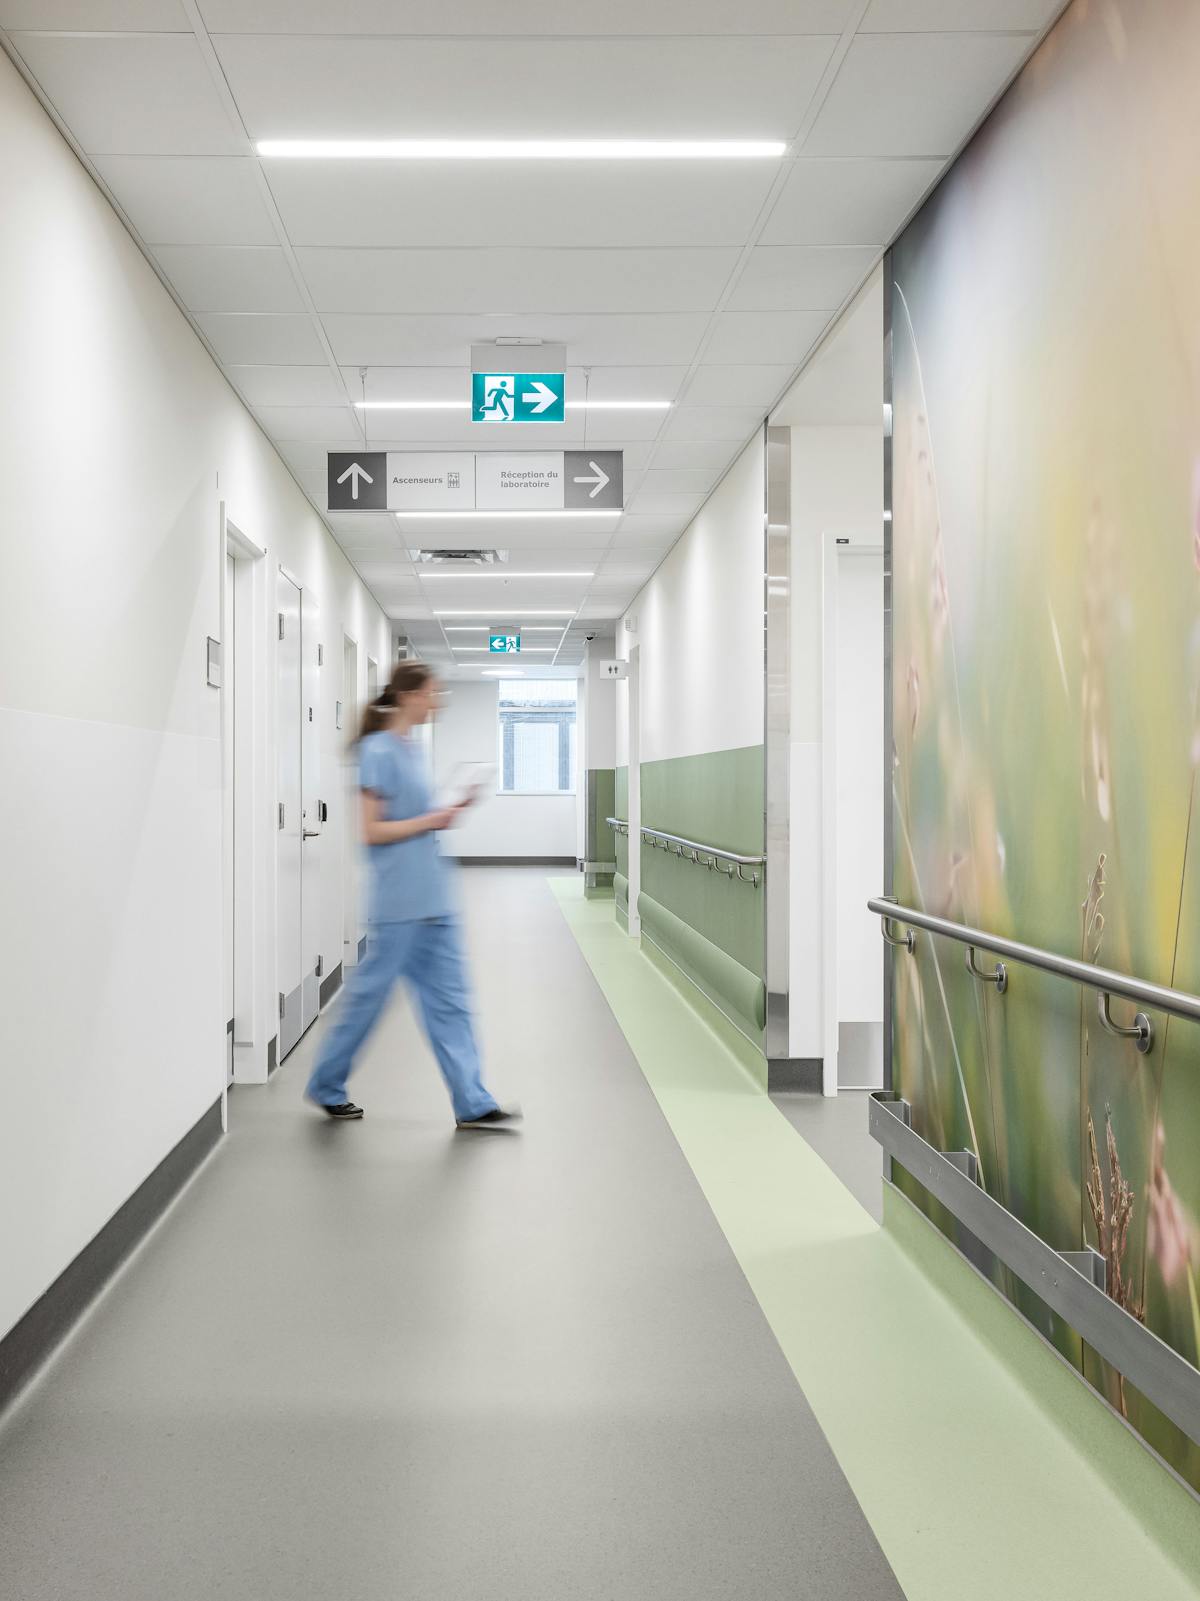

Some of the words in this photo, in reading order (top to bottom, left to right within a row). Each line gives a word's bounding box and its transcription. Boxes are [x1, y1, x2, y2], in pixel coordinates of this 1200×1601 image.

[500, 470, 544, 480] Réception
[392, 476, 443, 484] Ascenseurs
[500, 480, 550, 488] laboratoire
